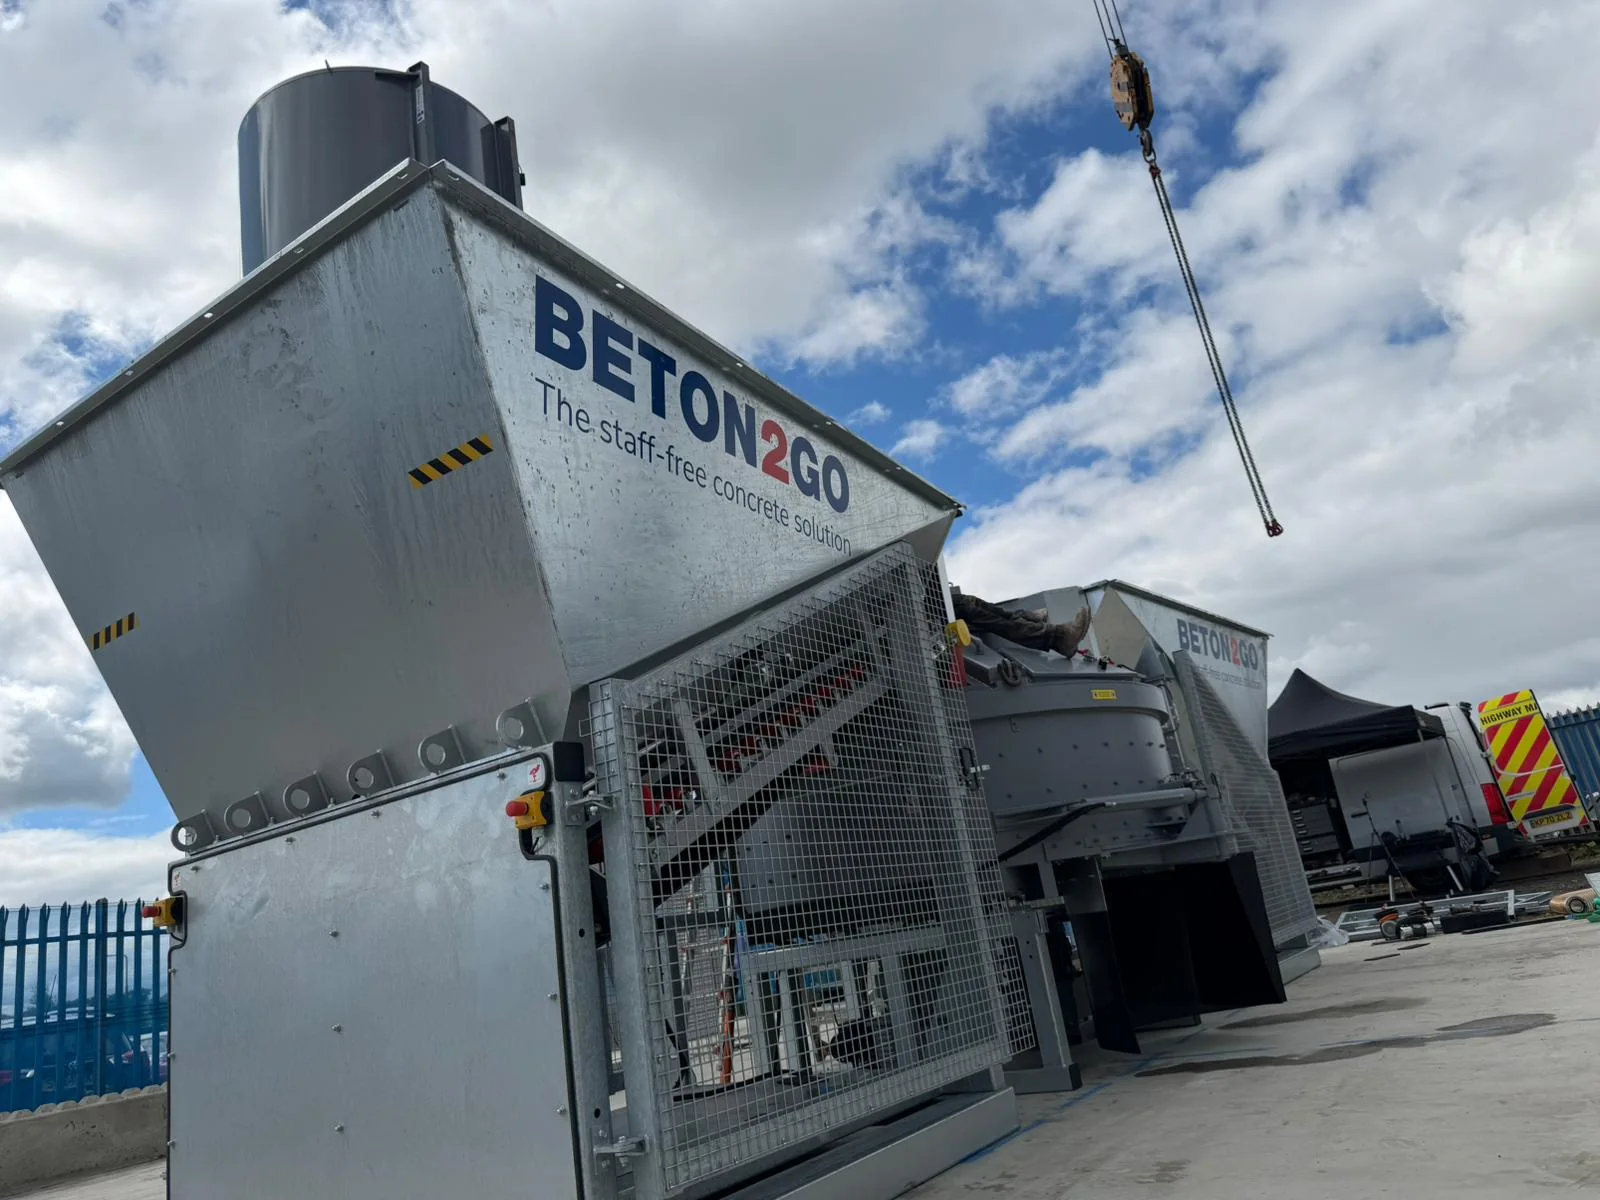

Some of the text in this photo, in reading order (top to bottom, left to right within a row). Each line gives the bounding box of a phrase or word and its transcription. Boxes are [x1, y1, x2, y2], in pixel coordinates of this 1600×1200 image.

[535, 274, 849, 513] BETON2GO
[535, 377, 851, 556] The staff-free concrete solution
[1177, 618, 1258, 671] BETON2GO
[1480, 706, 1522, 725] HIGHWAY
